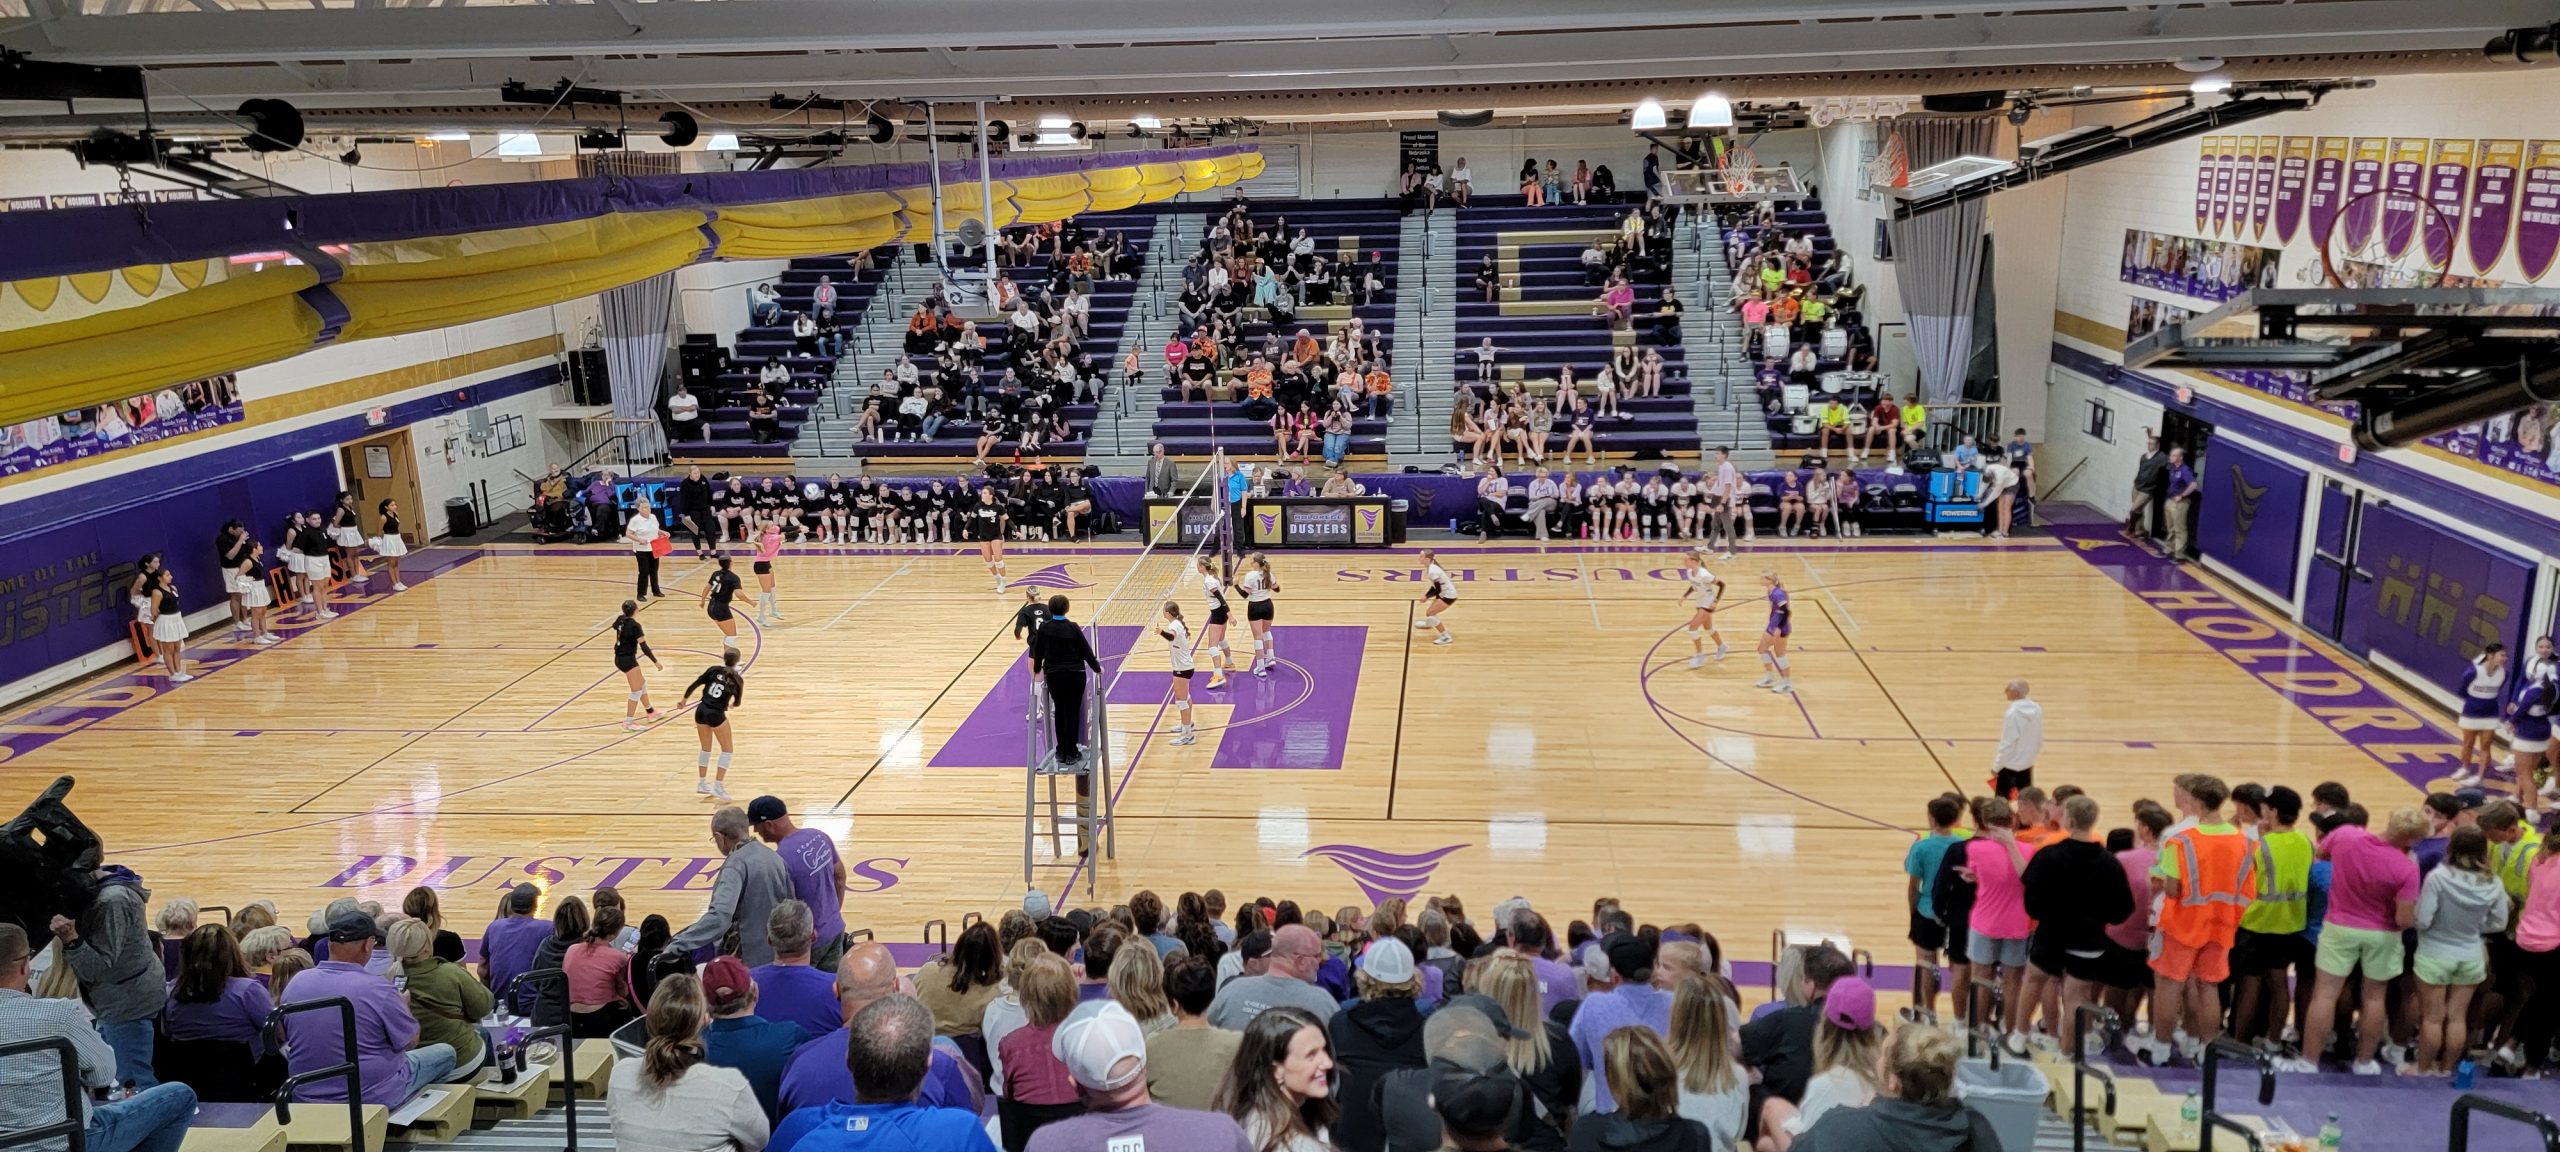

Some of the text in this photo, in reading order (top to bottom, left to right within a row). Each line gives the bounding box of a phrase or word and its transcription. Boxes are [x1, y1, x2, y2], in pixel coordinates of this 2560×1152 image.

[168, 190, 194, 201] HOLDREGE
[10, 201, 42, 210] HOLDREGE
[67, 196, 96, 207] HOLDREGE
[1185, 525, 1216, 535] DUST
[1289, 524, 1348, 534] DUSTERS
[708, 683, 724, 698] 16
[318, 855, 909, 892] DUSTES
